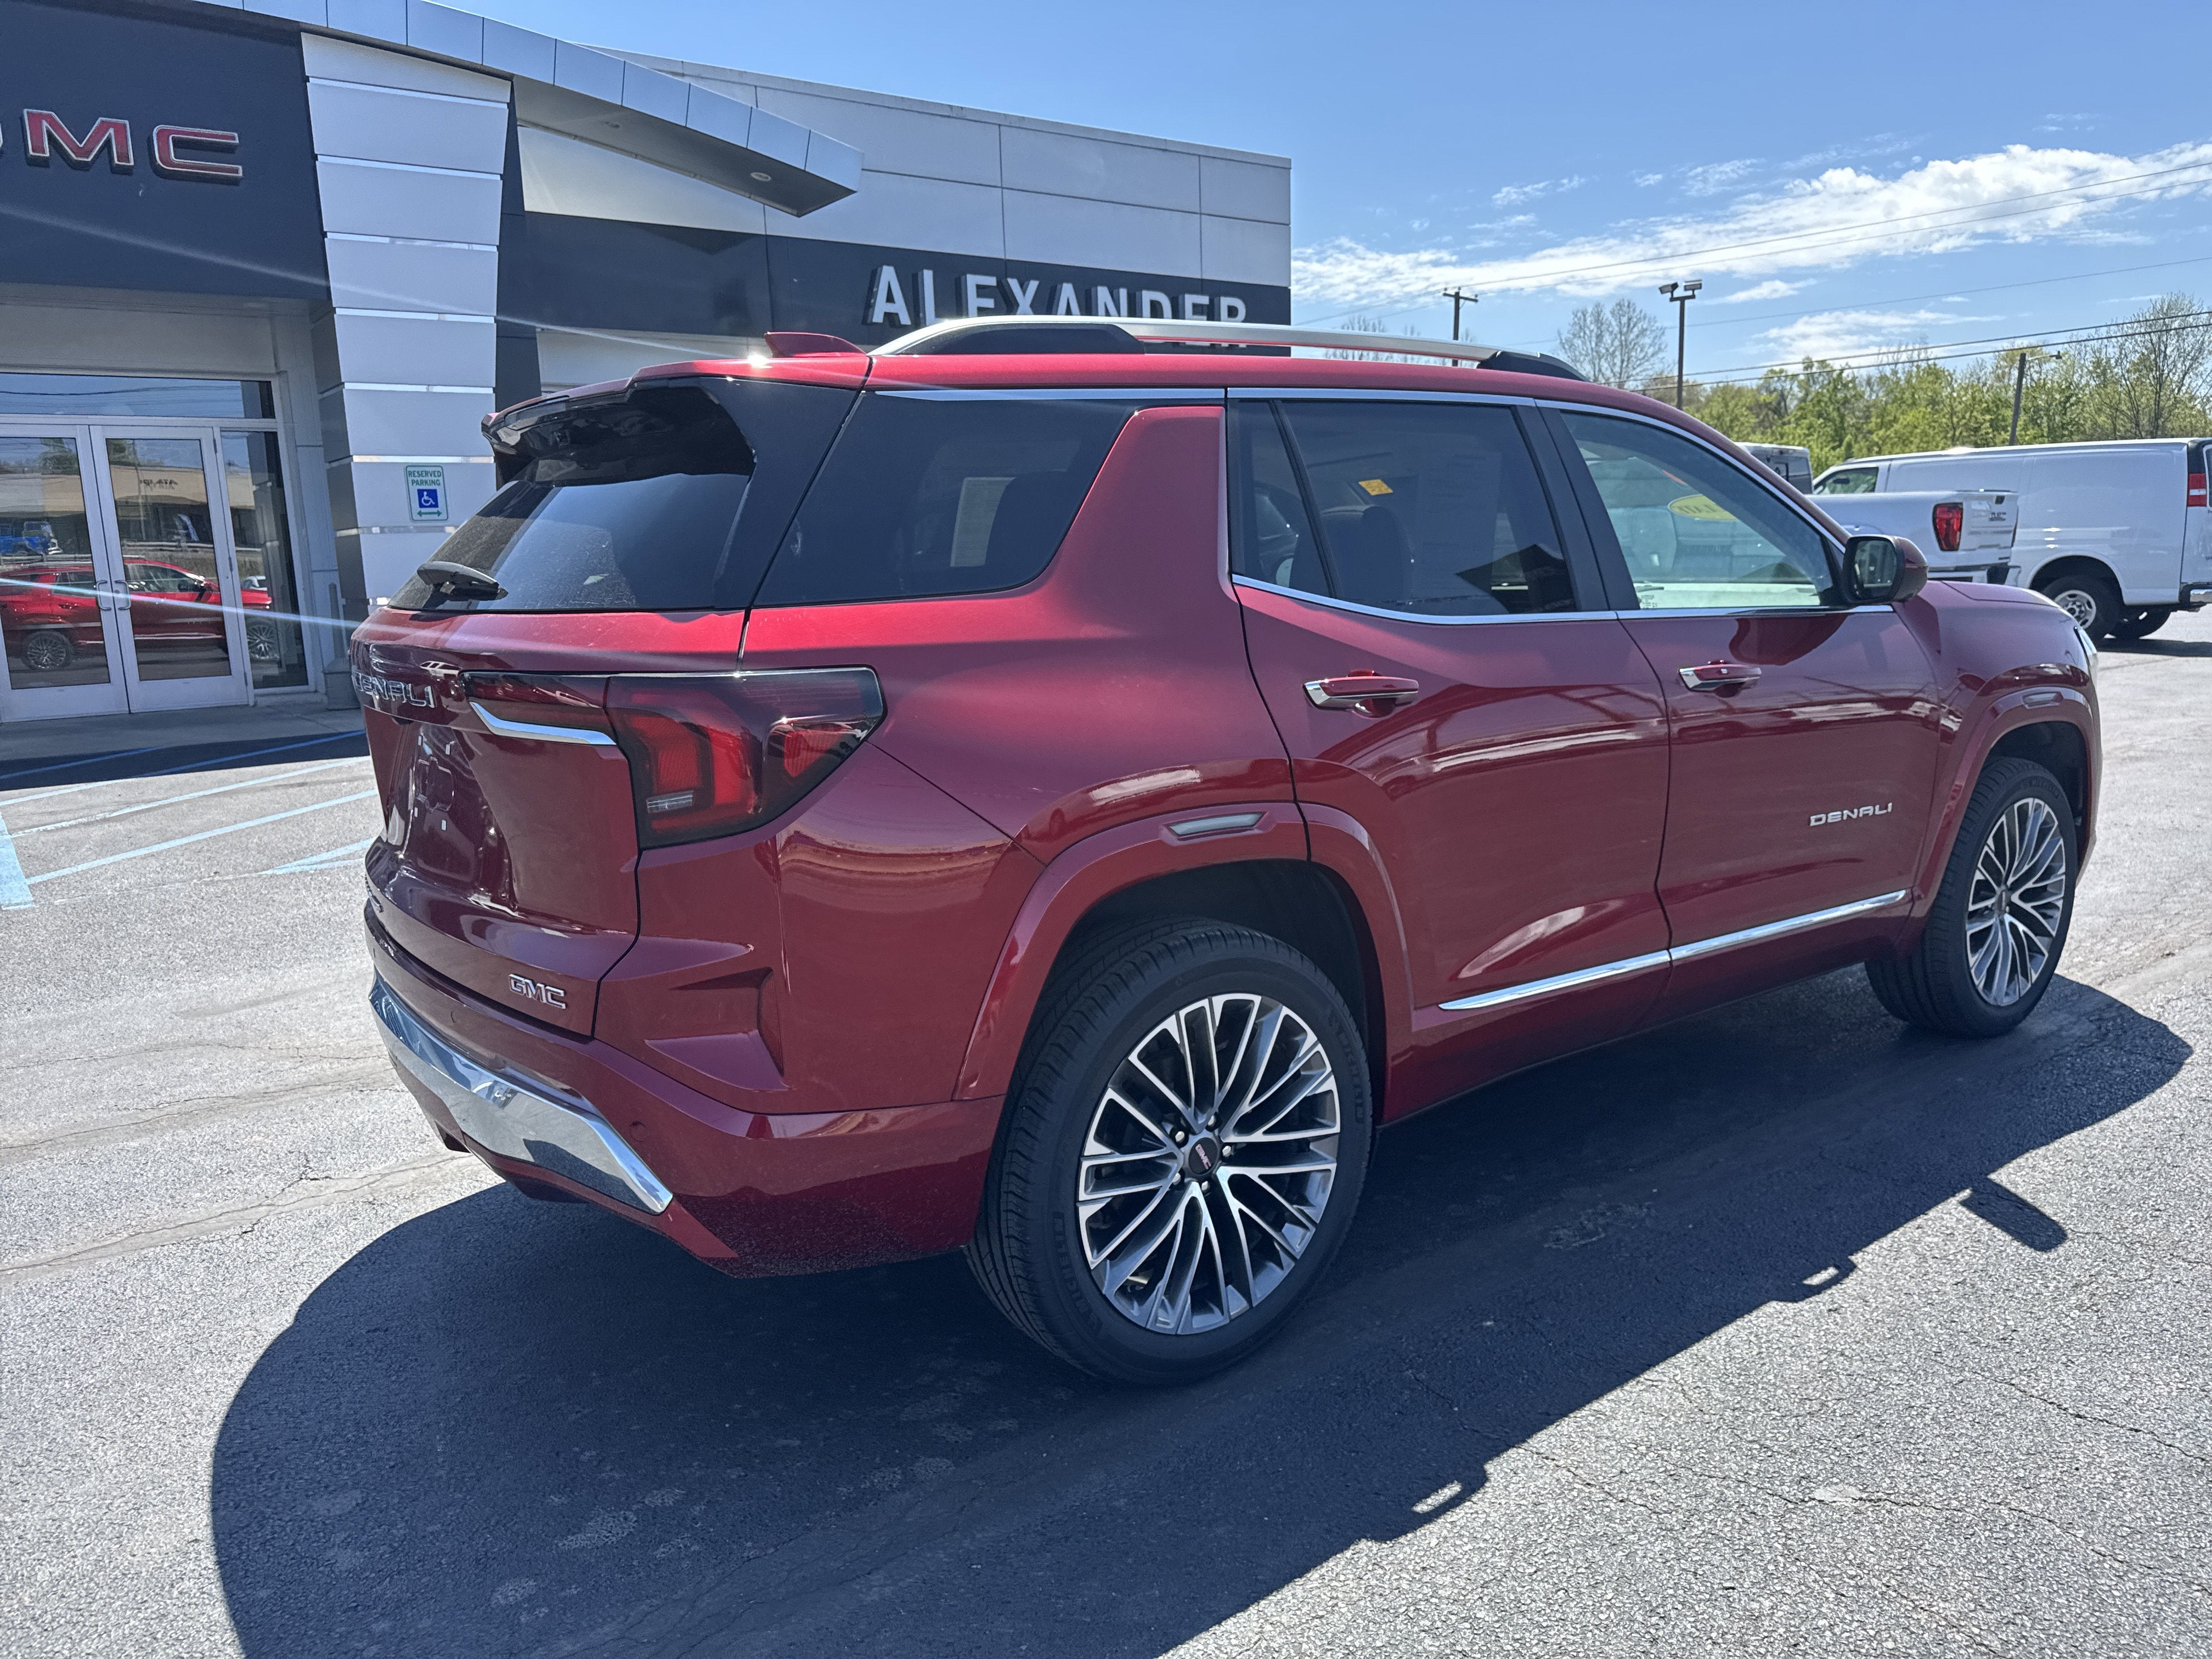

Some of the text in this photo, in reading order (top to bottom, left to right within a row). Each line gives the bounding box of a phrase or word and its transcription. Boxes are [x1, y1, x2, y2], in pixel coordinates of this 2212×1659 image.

[0, 109, 243, 177] MC
[864, 265, 1247, 347] ALEXANDER
[351, 669, 435, 709] DENALI
[1809, 802, 1893, 827] DENALI
[509, 974, 567, 1009] GMC
